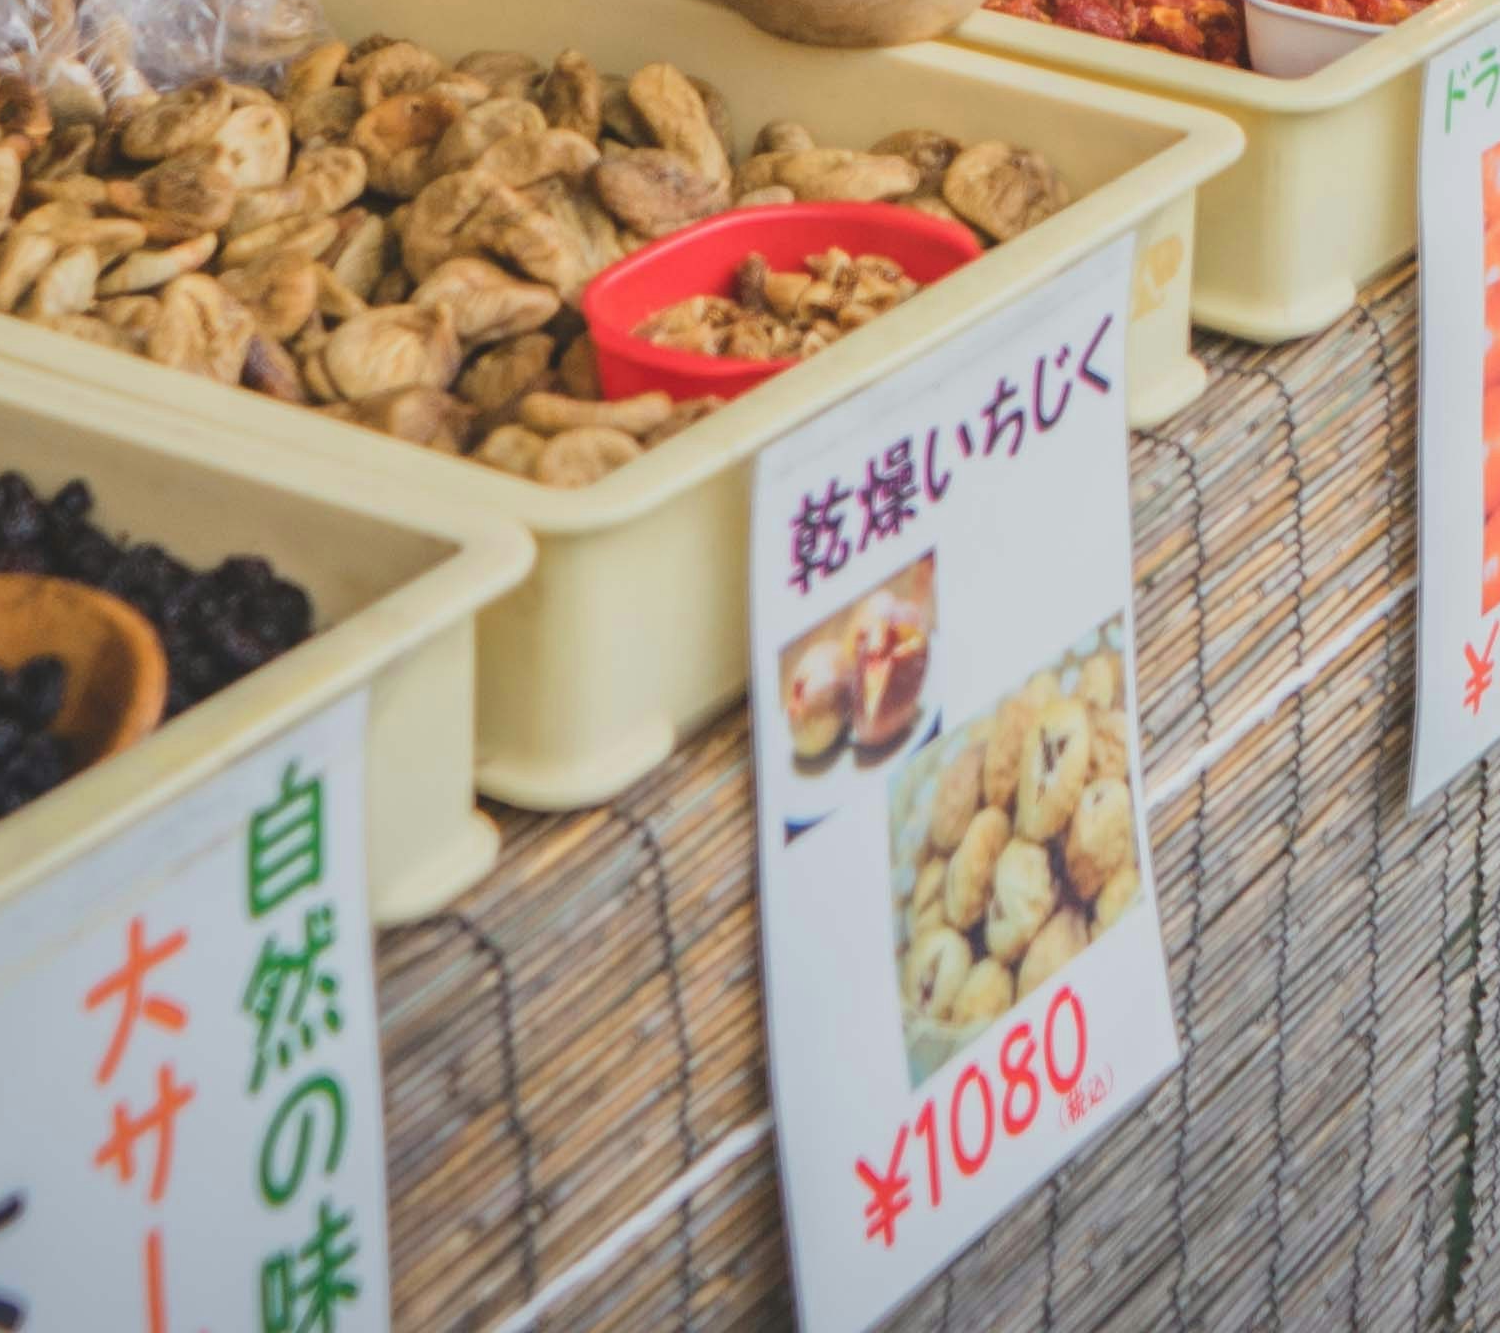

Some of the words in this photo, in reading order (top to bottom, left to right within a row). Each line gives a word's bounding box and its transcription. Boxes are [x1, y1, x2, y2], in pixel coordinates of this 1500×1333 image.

[787, 313, 1114, 596] 乾燥いちじく
[241, 761, 360, 1333] 自然の味
[854, 985, 1089, 1250] ¥1080
